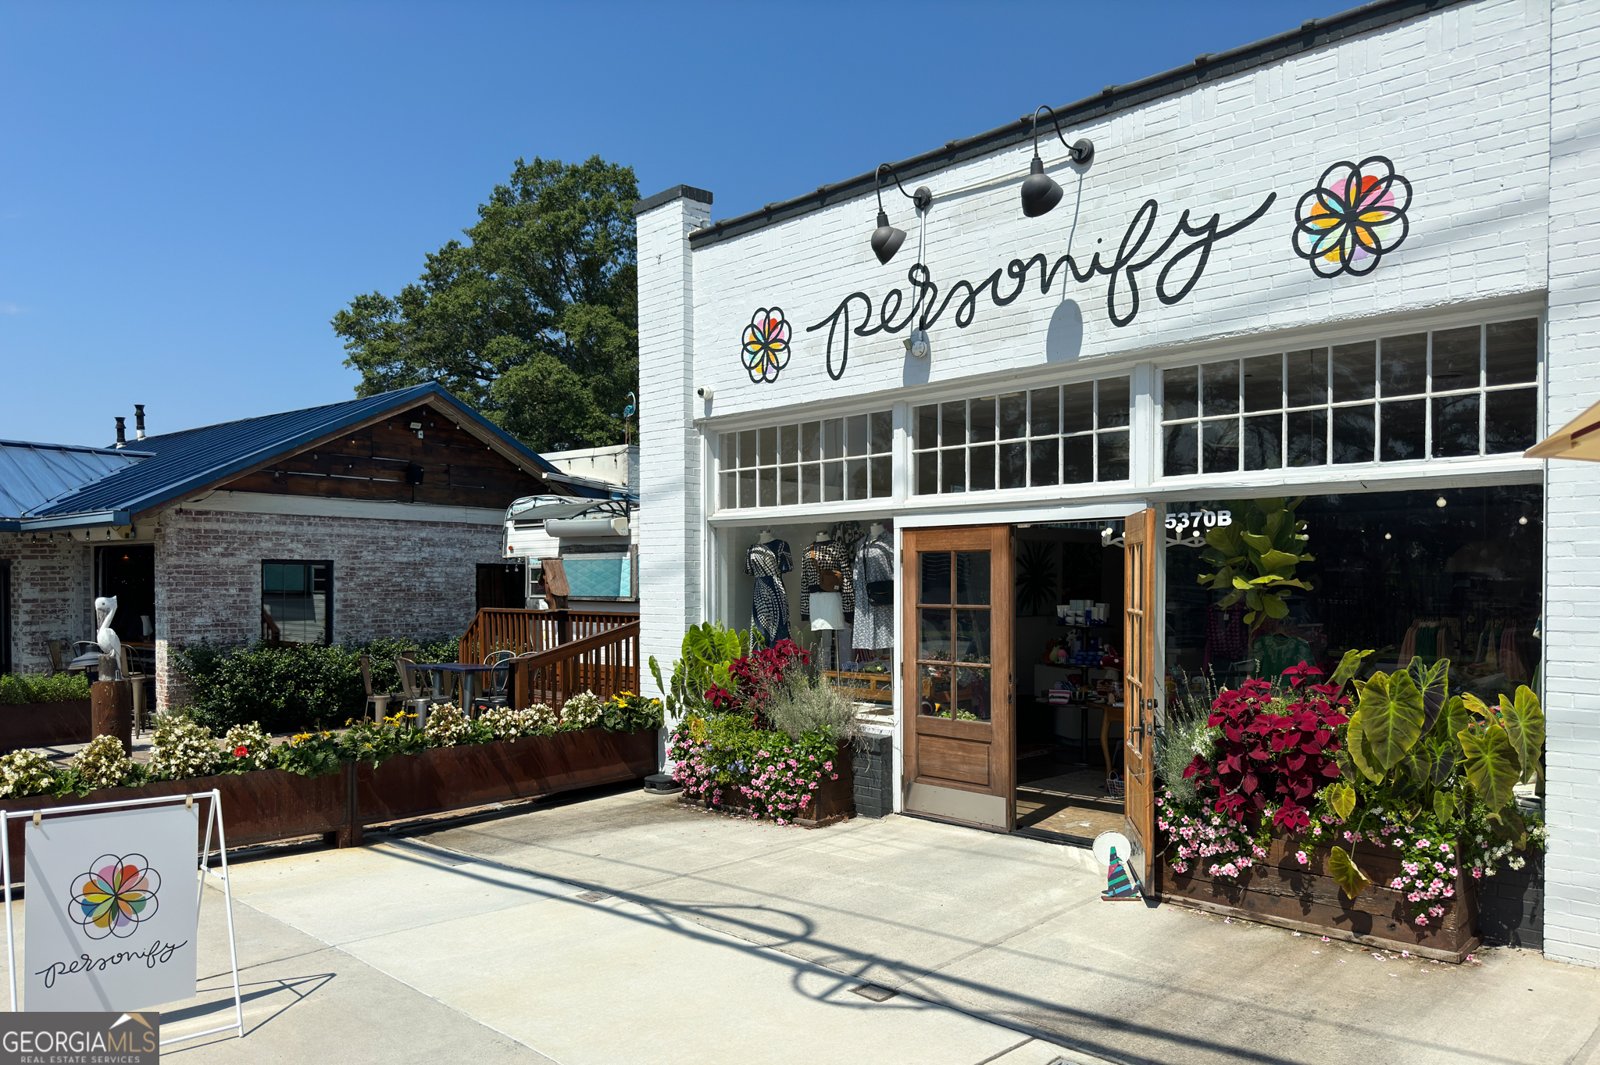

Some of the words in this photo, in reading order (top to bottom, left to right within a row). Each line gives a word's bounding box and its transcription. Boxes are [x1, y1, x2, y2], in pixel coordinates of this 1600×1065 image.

[807, 191, 1277, 381] personify
[1164, 510, 1233, 529] 5370B
[35, 940, 187, 988] personify
